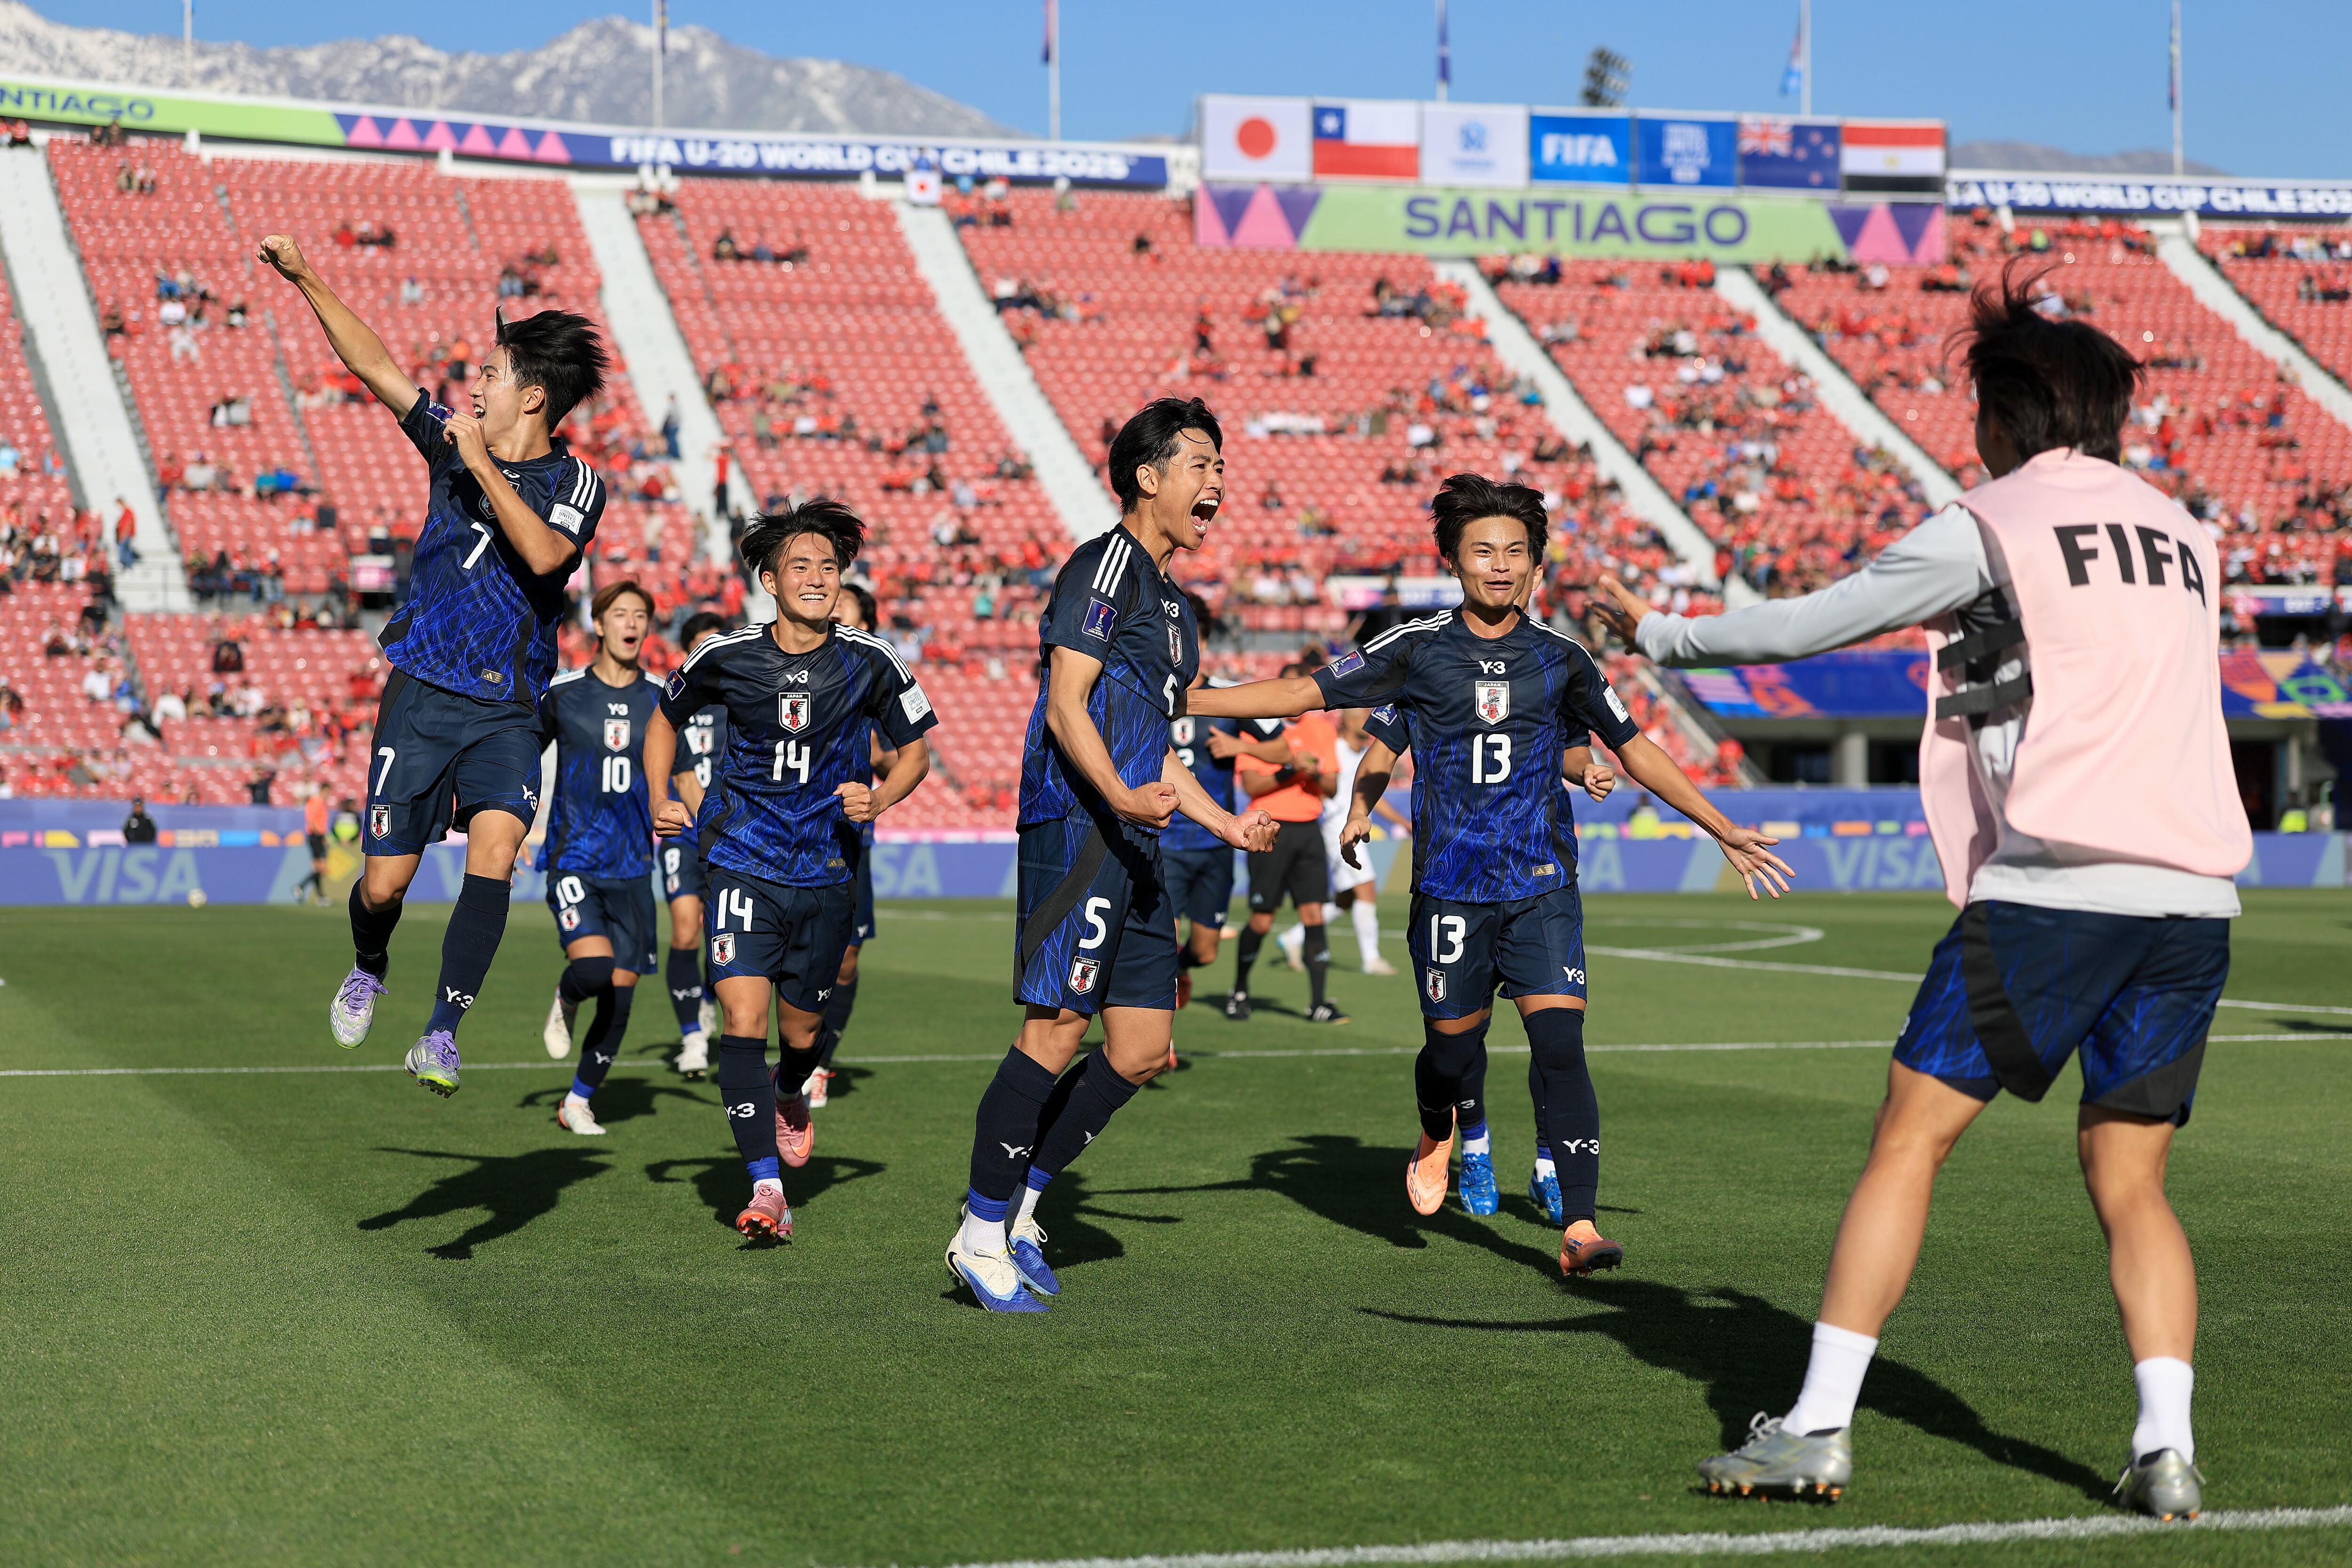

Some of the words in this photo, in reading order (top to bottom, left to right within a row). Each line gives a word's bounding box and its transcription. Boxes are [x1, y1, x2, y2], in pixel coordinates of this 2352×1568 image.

[610, 138, 683, 165] FIFA
[683, 140, 759, 168] U-20
[758, 143, 874, 172] WORLD
[941, 147, 1043, 176] CHILE
[1043, 150, 1130, 180] 2025
[1542, 132, 1617, 166] FIFA
[1984, 182, 2051, 207] U-20
[2051, 184, 2152, 210] WORLD
[2151, 186, 2209, 211] CUP
[2209, 187, 2298, 214] CHILE
[1405, 198, 1748, 245] SANTIAGO
[559, 512, 576, 523] UNITES
[560, 509, 576, 518] FOOTBALL
[462, 522, 494, 570] 7
[2053, 523, 2206, 608] FIFA
[1160, 598, 1179, 618] Y-3
[1478, 660, 1506, 674] Y-3
[607, 703, 628, 716] Y-3
[908, 694, 922, 706] UNITES
[375, 746, 396, 796] 7
[602, 756, 631, 793] 10
[773, 740, 810, 784] 14
[1473, 734, 1511, 784] 13
[521, 784, 538, 811] Y-3
[40, 849, 201, 902] VISA
[664, 847, 681, 876] 8
[556, 876, 586, 909] 10
[717, 888, 754, 932] 14
[1079, 896, 1111, 950] 5
[1431, 914, 1466, 964] 13
[1563, 966, 1585, 985] Y-3
[446, 986, 474, 1009] Y-3
[672, 985, 703, 1001] Y-3
[817, 987, 832, 1001] Y-3
[724, 1102, 755, 1121] Y-3
[1562, 1139, 1599, 1155] Y-3
